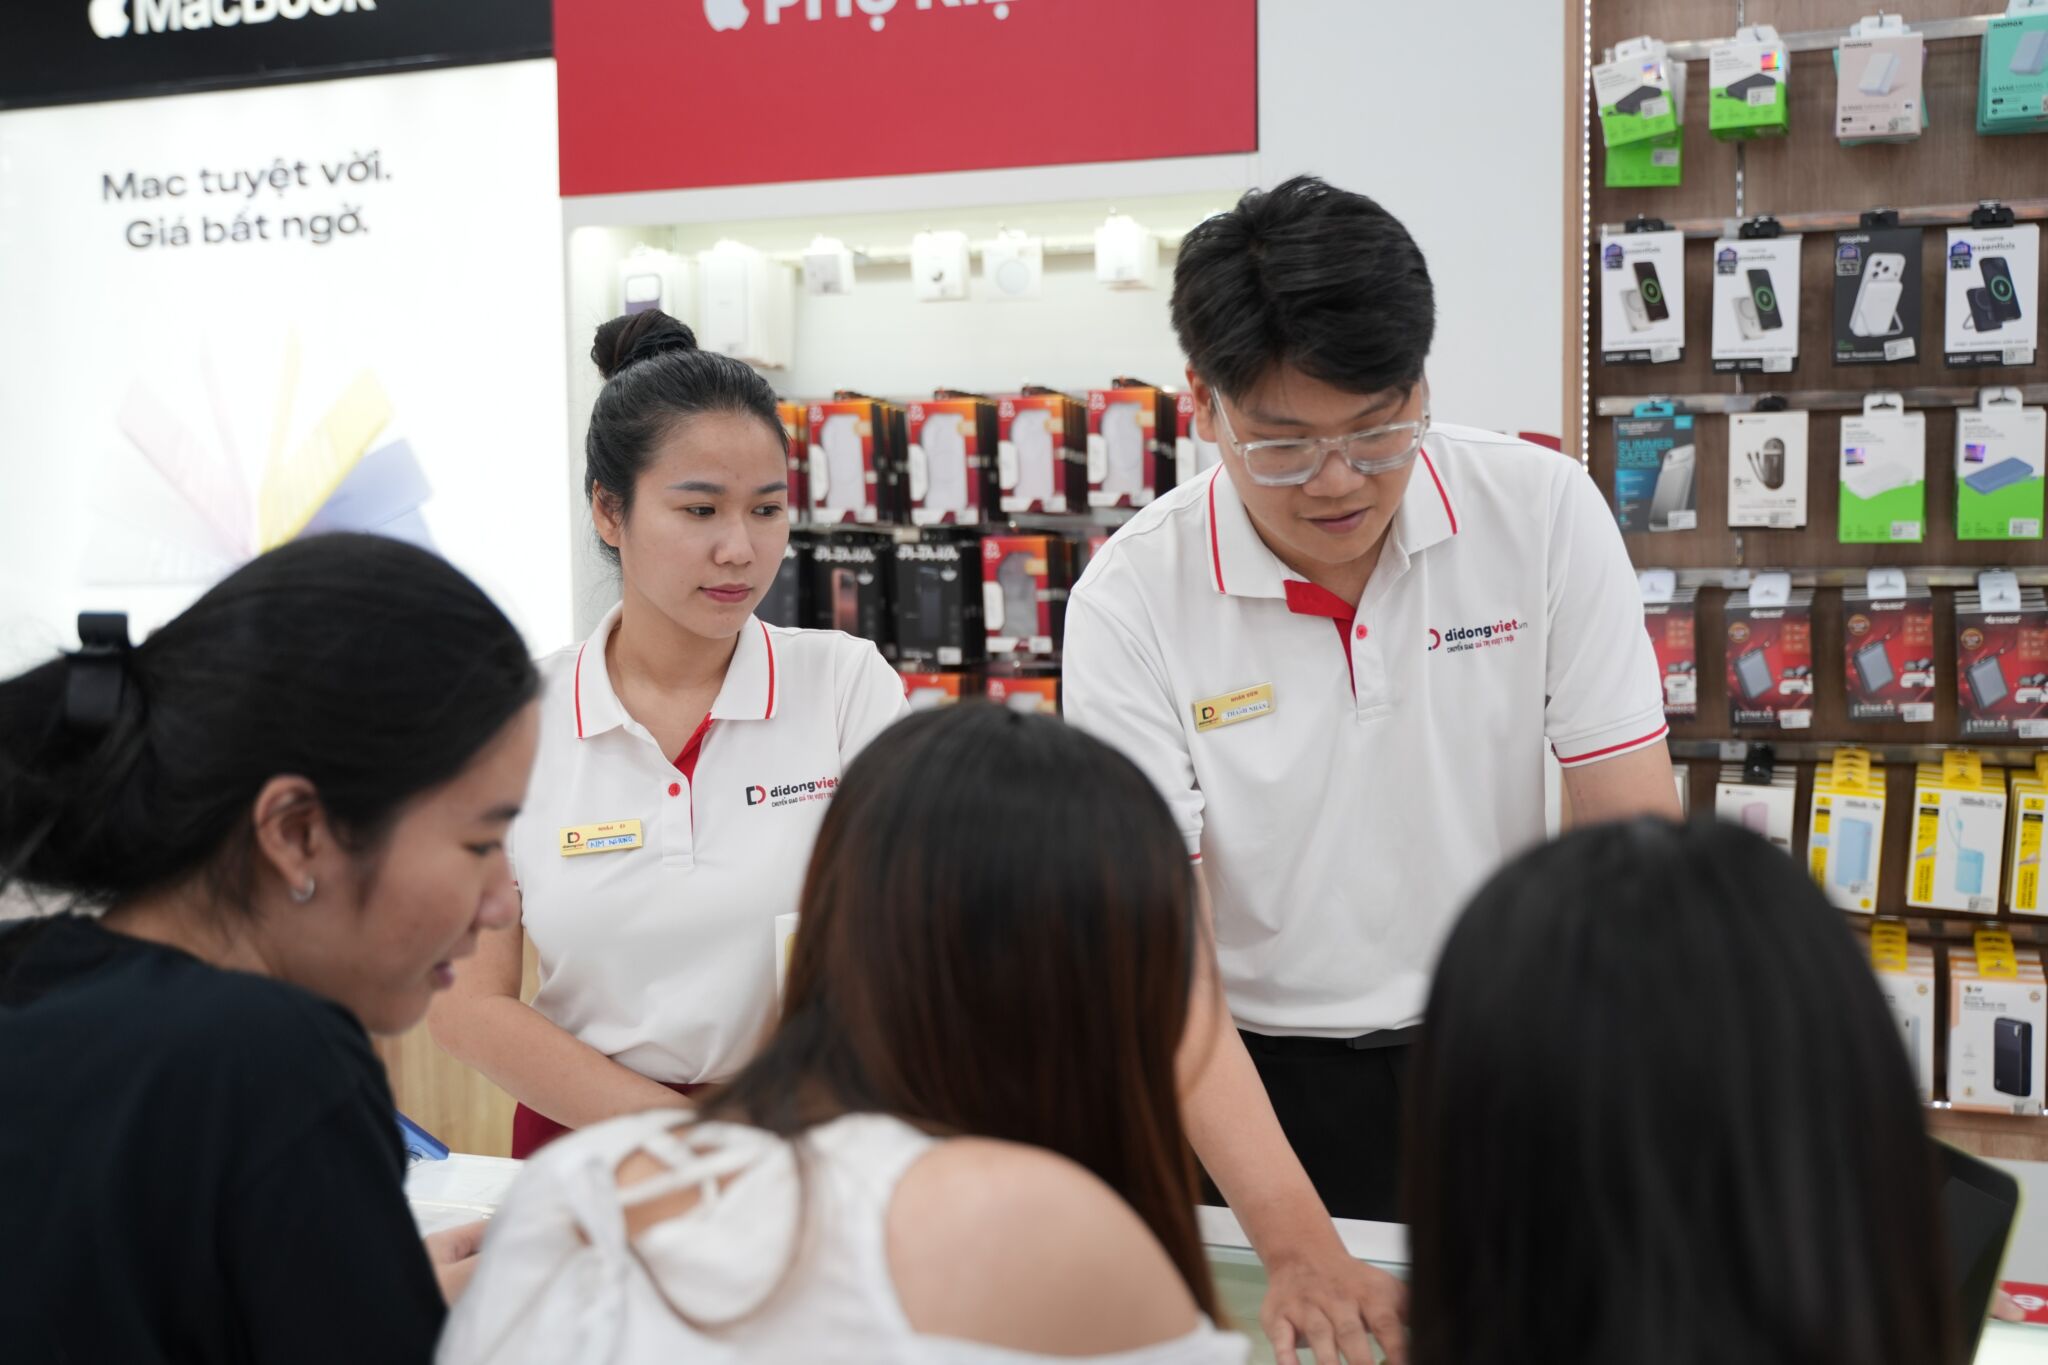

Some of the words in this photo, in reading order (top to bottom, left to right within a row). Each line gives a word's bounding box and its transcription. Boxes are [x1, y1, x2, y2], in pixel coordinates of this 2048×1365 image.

[133, 0, 378, 35] MacBoo
[102, 171, 187, 201] Mac
[201, 157, 309, 199] tuyệt
[126, 215, 190, 248] Giá
[202, 206, 269, 244] bất
